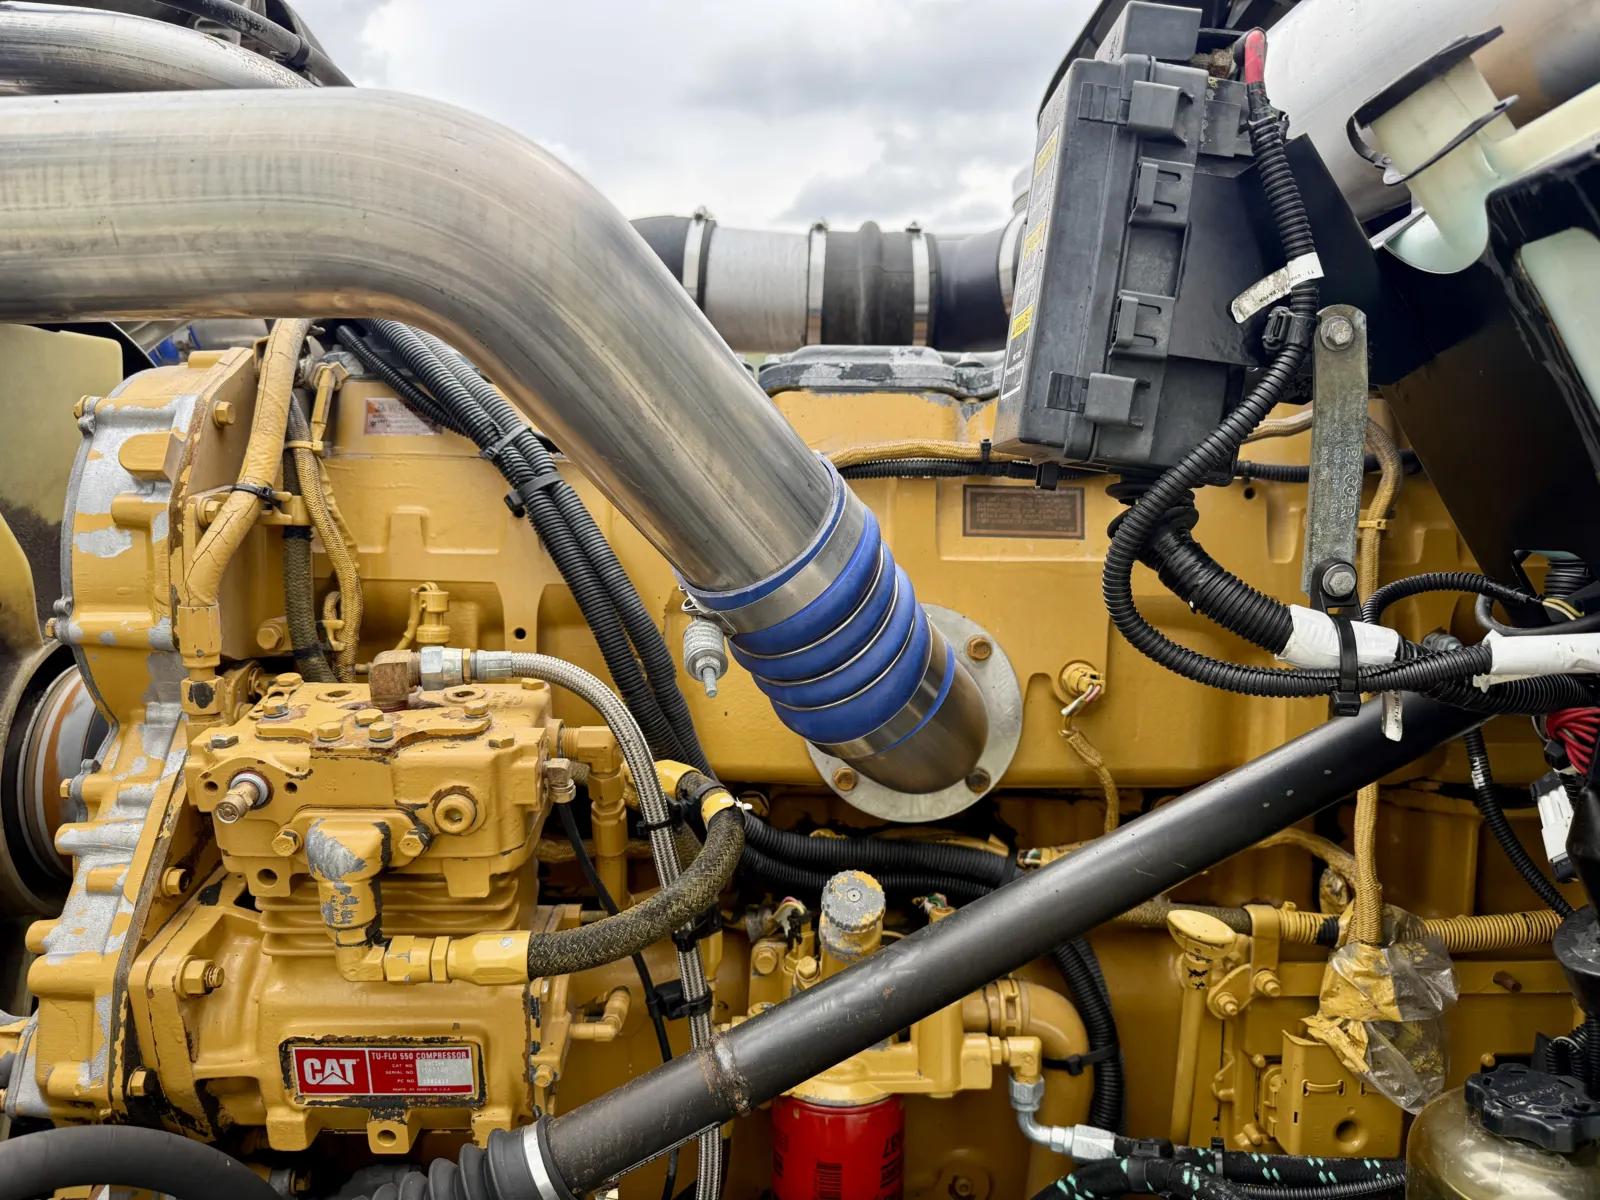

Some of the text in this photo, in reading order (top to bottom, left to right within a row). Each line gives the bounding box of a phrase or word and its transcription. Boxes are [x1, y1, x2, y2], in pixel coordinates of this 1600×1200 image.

[371, 1051, 467, 1060] TU-FLO 550 COMPRESSOR
[303, 1058, 357, 1085] CAT
